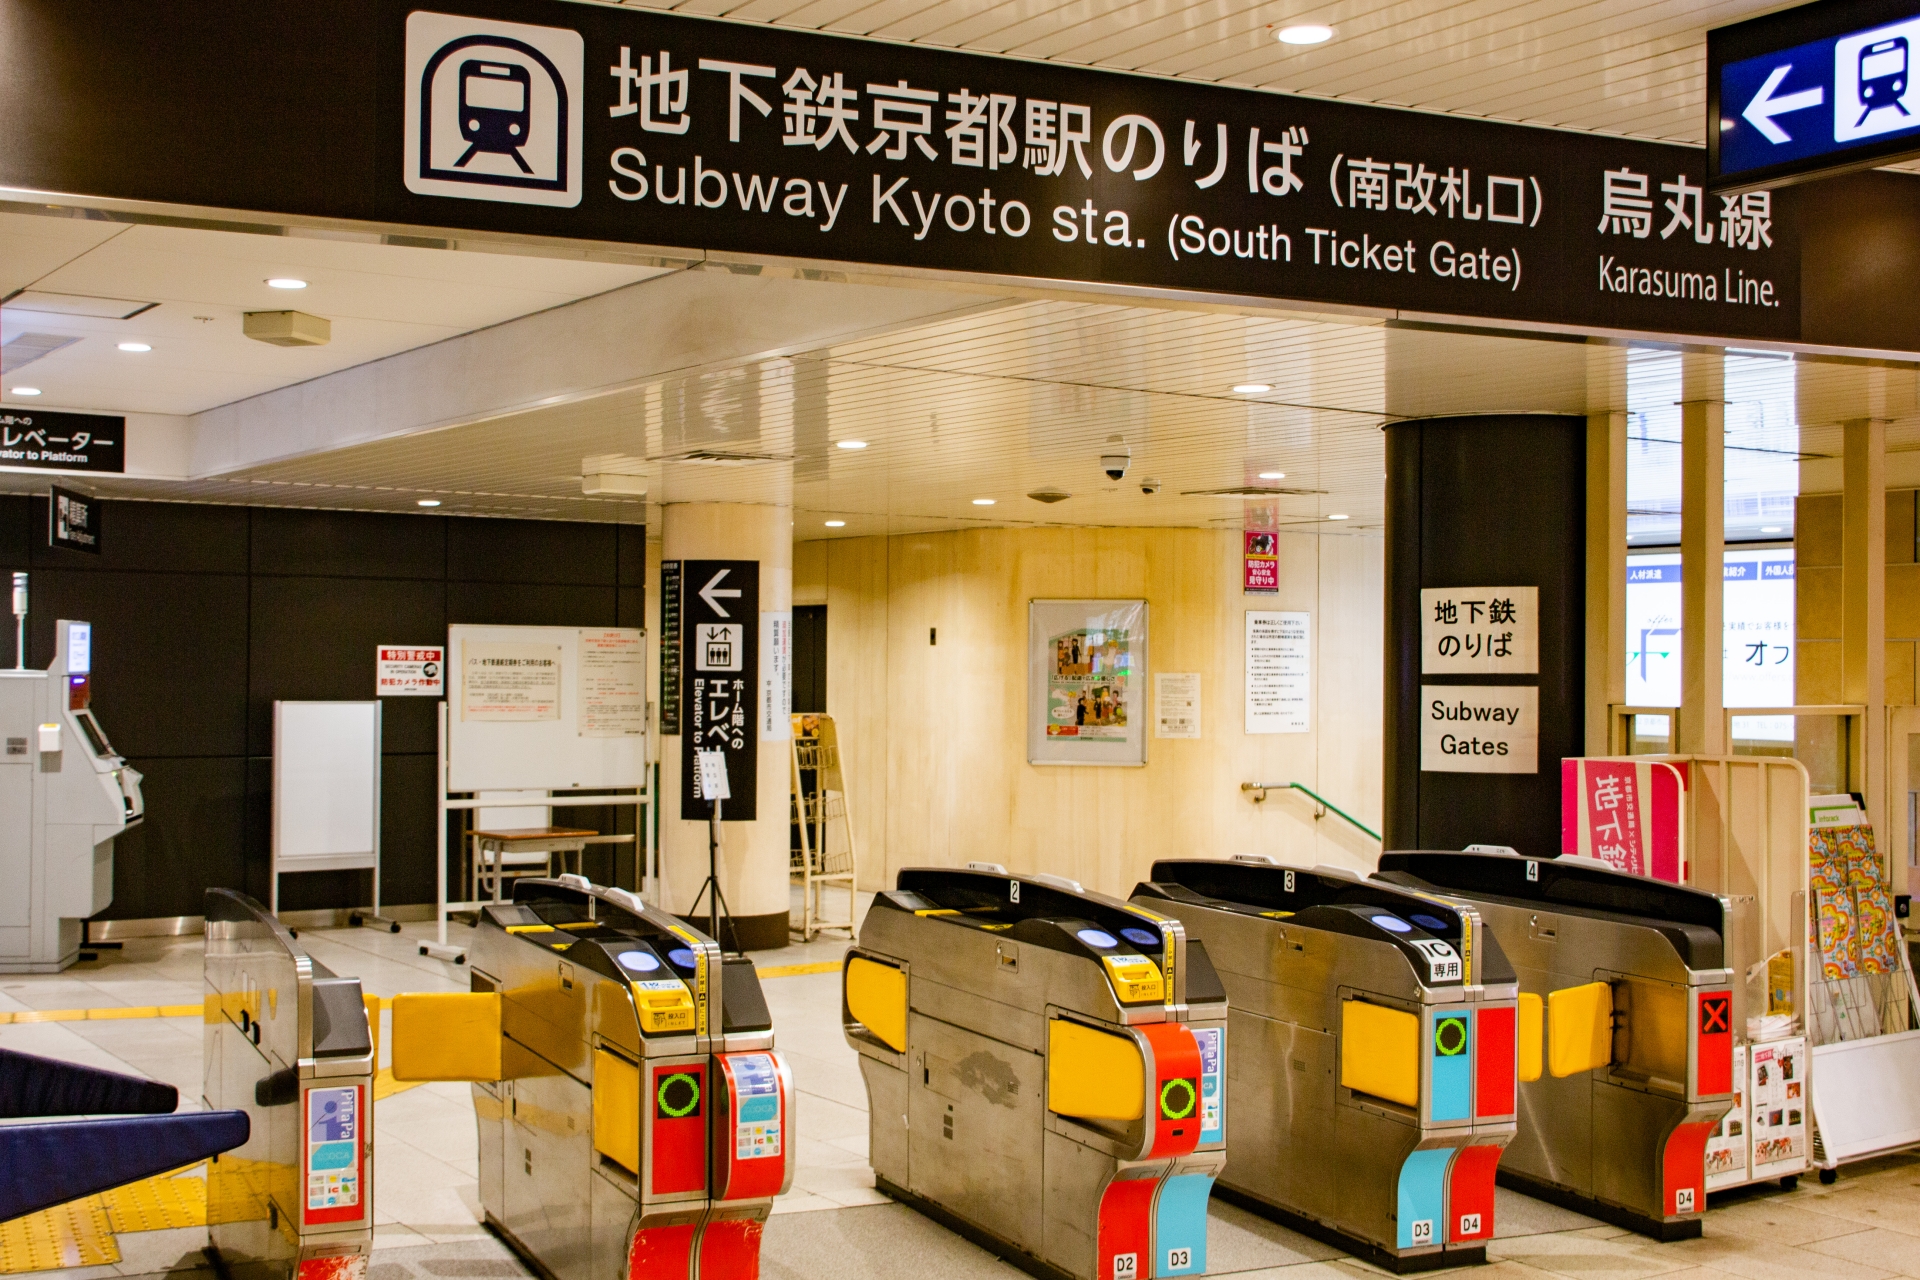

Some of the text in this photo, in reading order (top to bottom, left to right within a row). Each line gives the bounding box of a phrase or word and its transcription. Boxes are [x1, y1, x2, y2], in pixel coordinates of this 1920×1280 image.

[609, 46, 1773, 250] 地下鉄京都駅のりば (南改札口) 烏丸線
[609, 147, 1521, 291] Subway Kyoto sta. (South Ticket Gate)
[1600, 255, 1780, 307] Karasuma Line.
[4, 426, 114, 451] レベーター
[27, 450, 39, 460] to
[41, 451, 88, 462] Platform
[1435, 598, 1517, 624] 地下鉄
[1438, 631, 1513, 658] のりば
[694, 678, 705, 728] Elevator
[1431, 700, 1520, 725] Subway
[732, 678, 744, 749] ホーム階への
[694, 731, 704, 744] to
[1440, 734, 1509, 756] Gates
[1528, 862, 1536, 879] 4
[1286, 872, 1293, 890] 3
[1012, 882, 1018, 901] 2
[1420, 942, 1452, 958] IC
[1433, 962, 1458, 977] 専用
[1207, 1032, 1217, 1073] PiTaPa
[1678, 1191, 1692, 1205] D4
[1415, 1222, 1430, 1237] D3
[1463, 1217, 1478, 1231] D4
[1117, 1257, 1133, 1272] D2
[1171, 1251, 1188, 1266] D3
